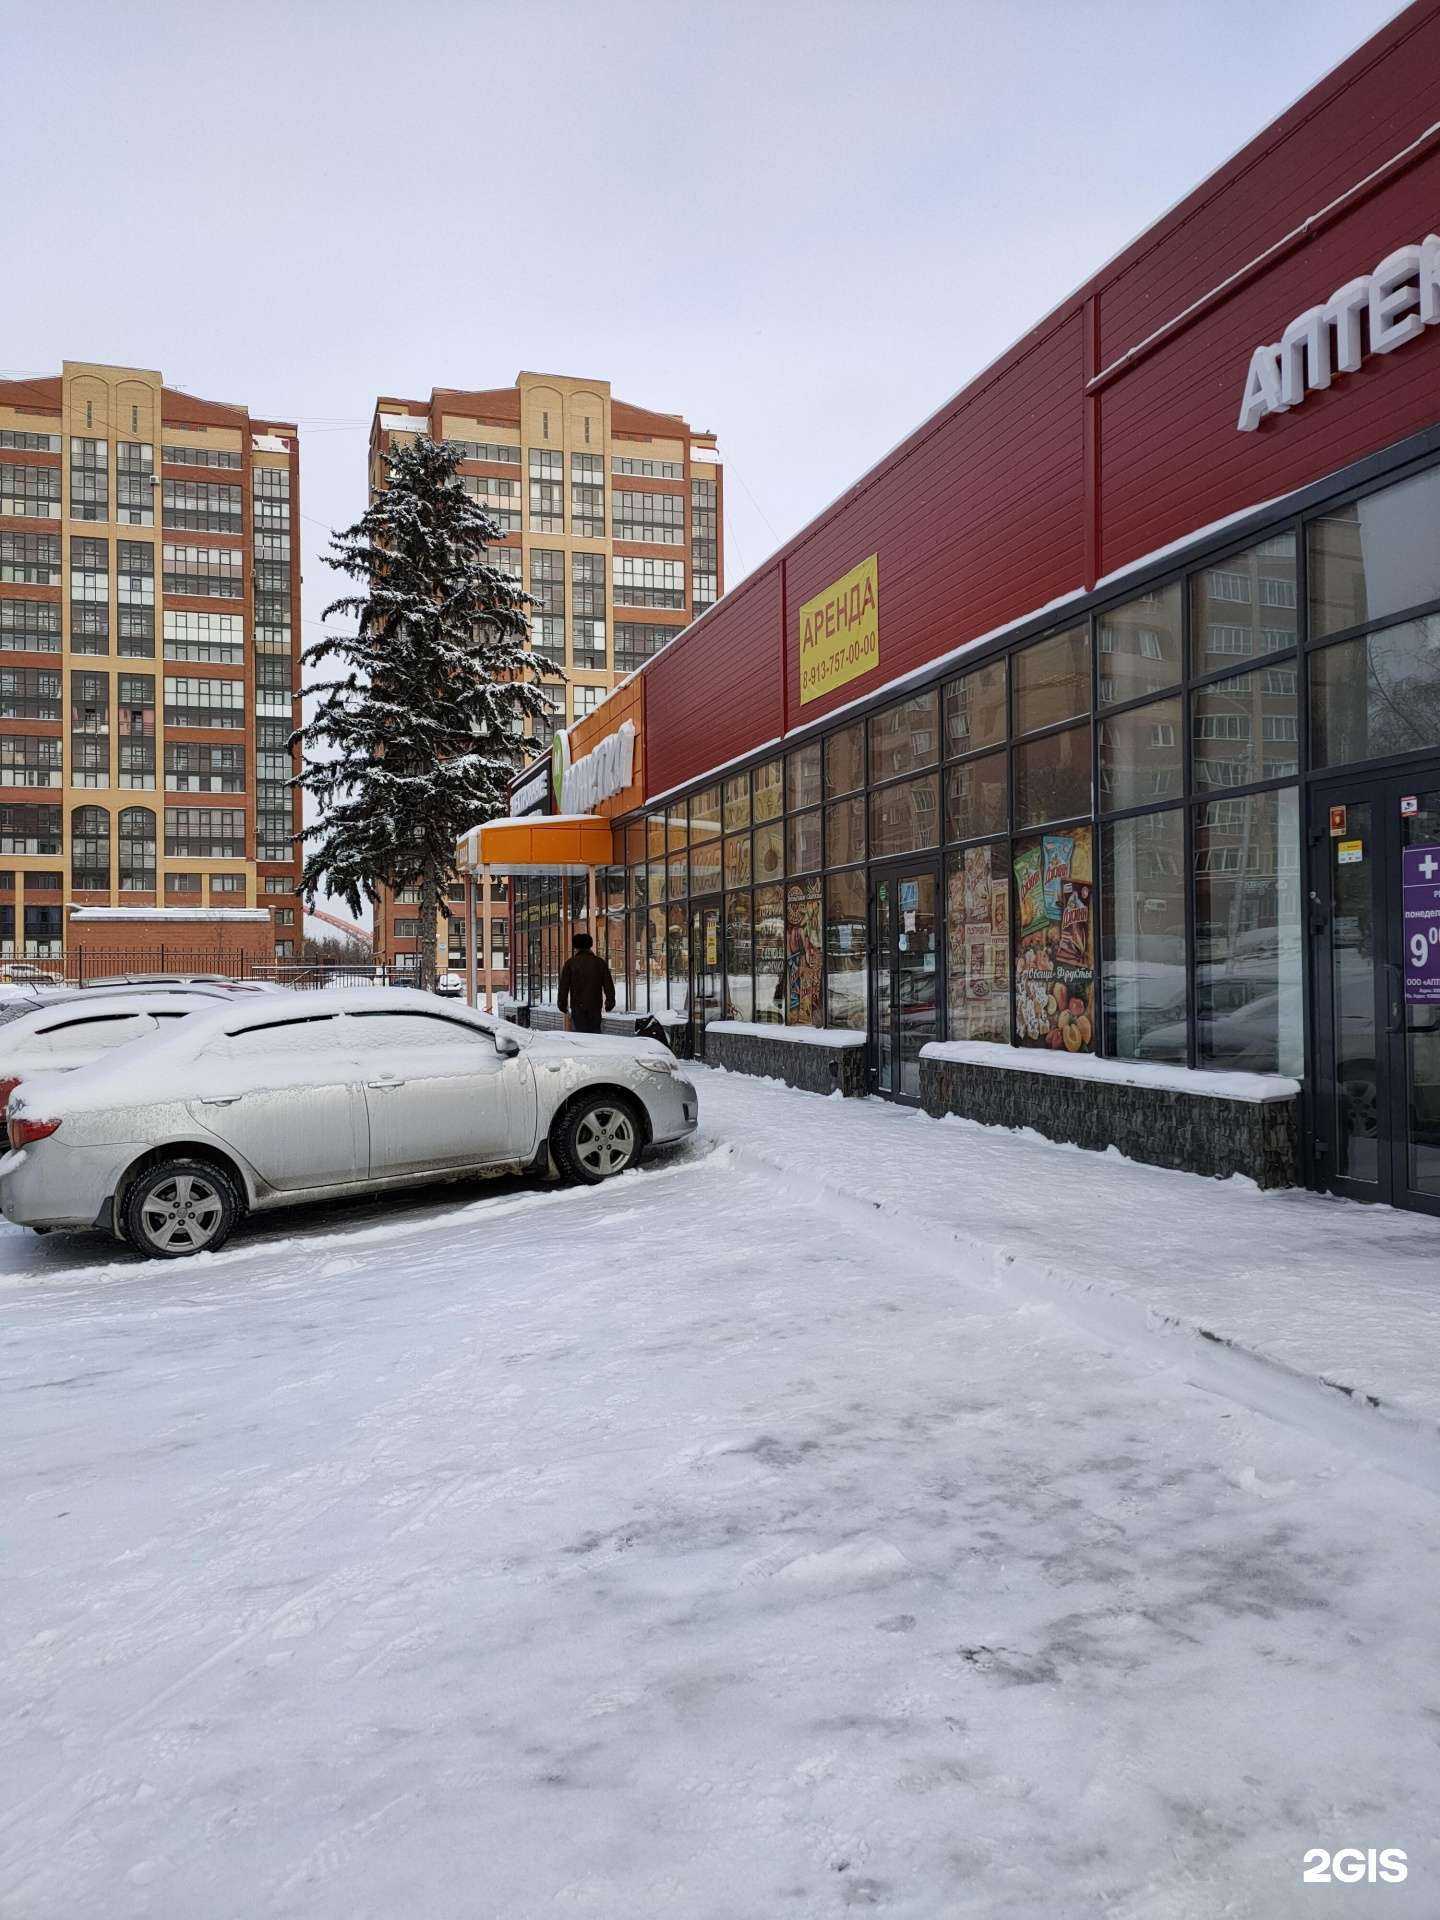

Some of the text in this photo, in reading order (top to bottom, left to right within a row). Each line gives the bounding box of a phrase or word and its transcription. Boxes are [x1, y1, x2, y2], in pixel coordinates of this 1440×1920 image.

[803, 576, 876, 653] АРЕНДА
[803, 631, 876, 689] 8-913-757-00-00
[1407, 978, 1422, 986] ООО
